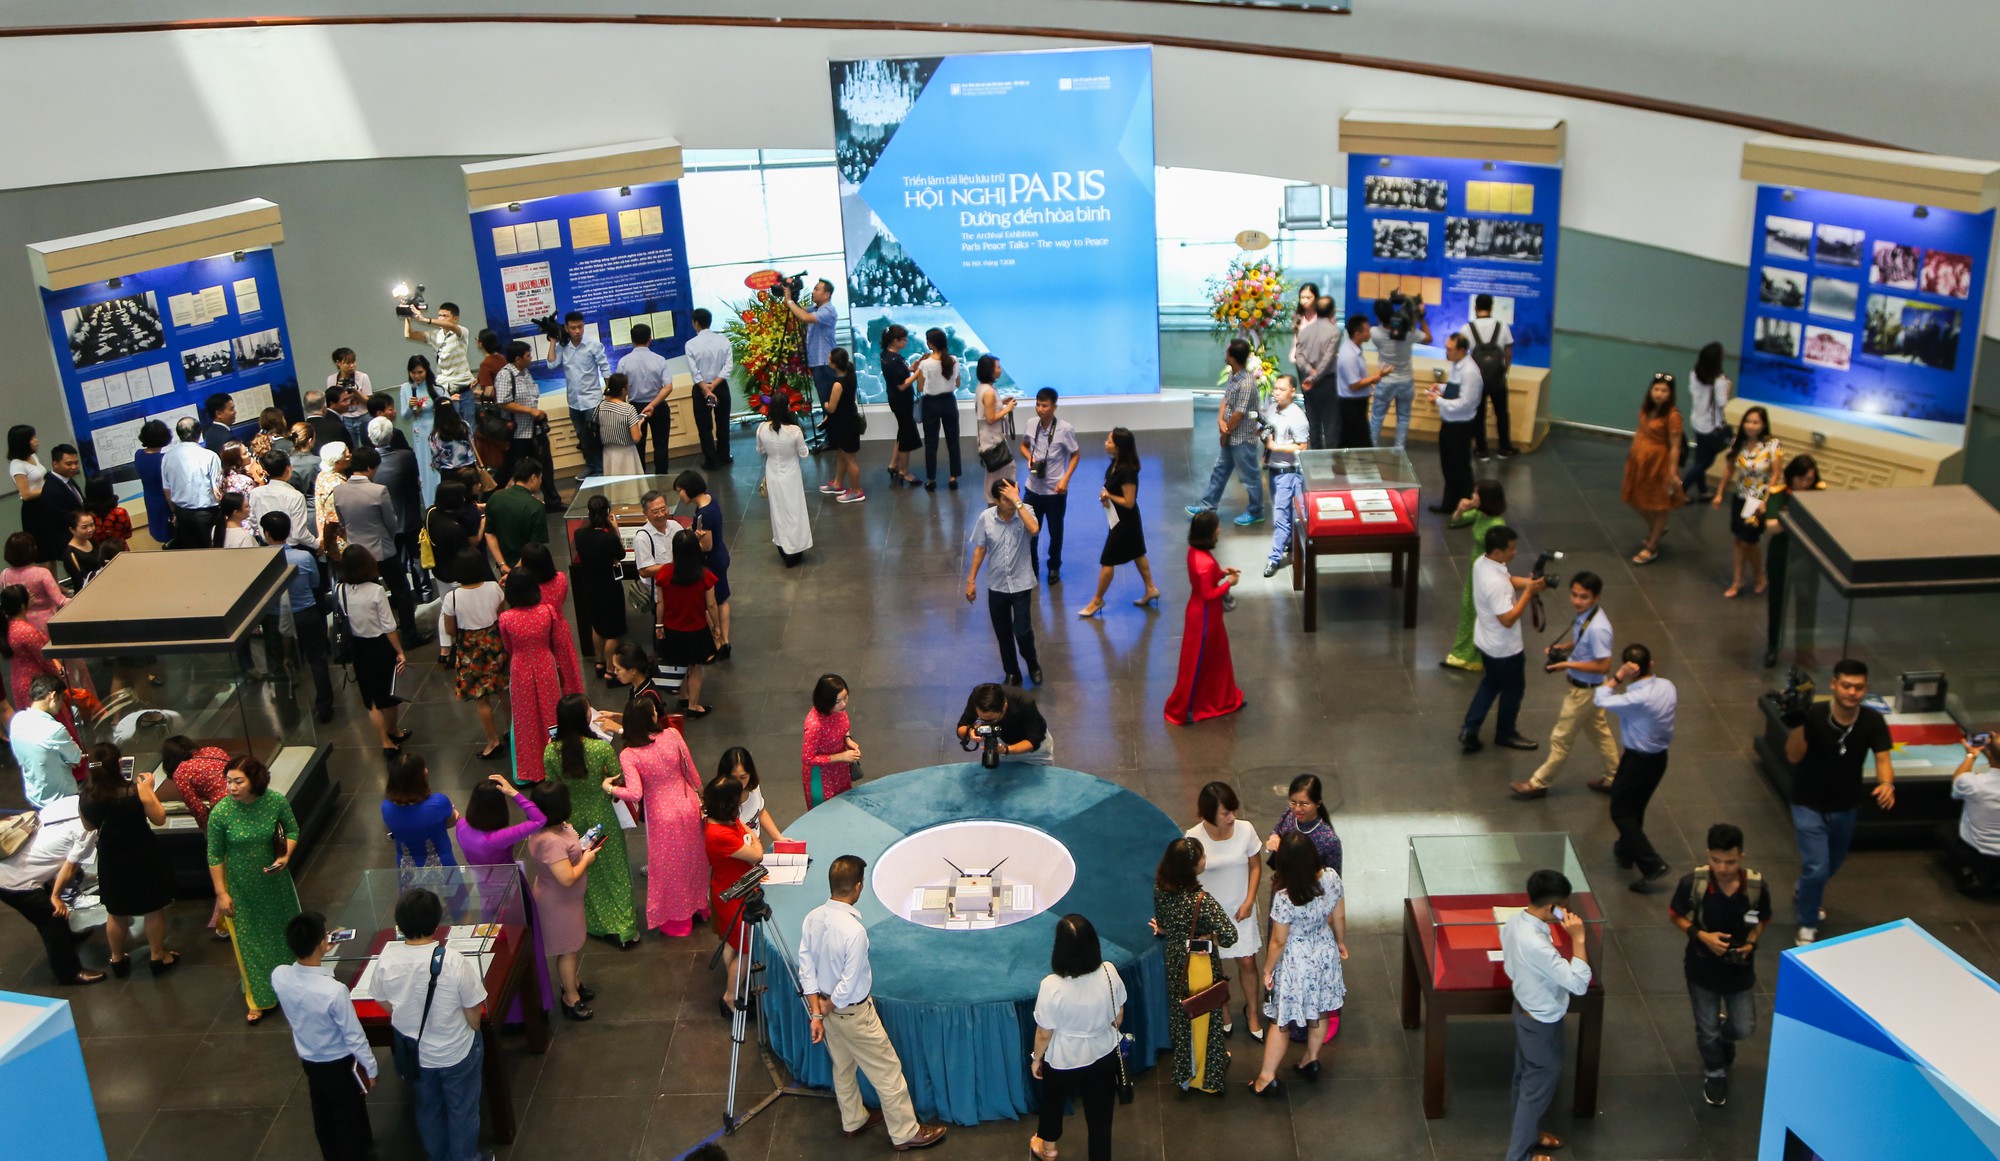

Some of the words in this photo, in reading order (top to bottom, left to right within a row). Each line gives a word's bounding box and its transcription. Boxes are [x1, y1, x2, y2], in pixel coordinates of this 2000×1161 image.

[904, 186, 944, 210] HỘI
[952, 186, 1007, 207] NGHỊ
[1008, 169, 1106, 204] PARIS
[960, 210, 1012, 229] Đường
[1013, 206, 1044, 225] đến
[1045, 206, 1075, 224] hòa
[1076, 204, 1111, 222] bình
[961, 232, 975, 240] The
[976, 231, 1004, 239] Archival
[961, 242, 981, 251] Paris
[982, 241, 1007, 251] Peace
[1008, 240, 1030, 249] Talks
[1037, 239, 1053, 248] The
[1054, 240, 1072, 250] way
[1074, 238, 1084, 247] to
[1085, 237, 1110, 247] Peace
